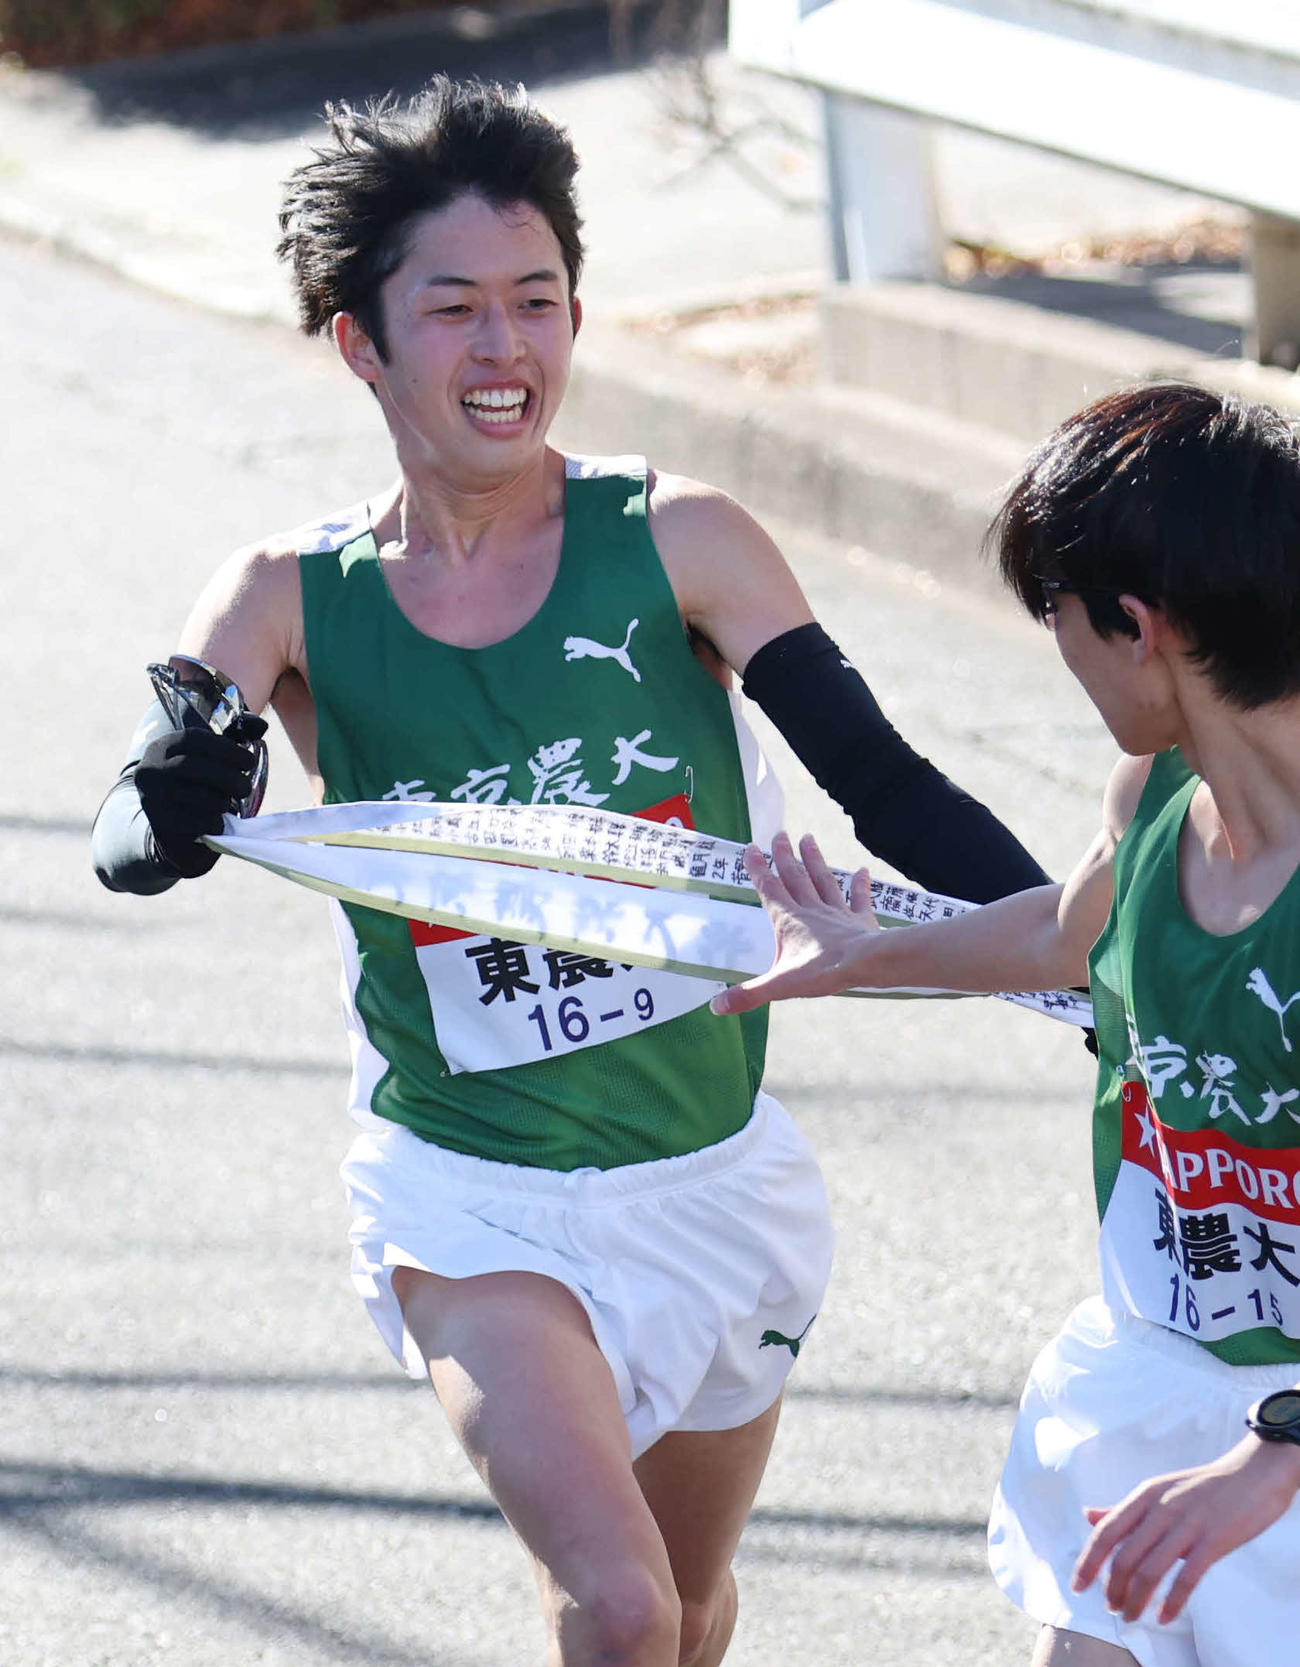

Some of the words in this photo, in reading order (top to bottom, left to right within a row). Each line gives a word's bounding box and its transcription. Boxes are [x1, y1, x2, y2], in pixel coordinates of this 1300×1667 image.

[465, 937, 634, 1006] 東農
[528, 987, 655, 1051] 16-9
[1126, 1013, 1300, 1127] 京農大
[1169, 1273, 1284, 1331] 16-15
